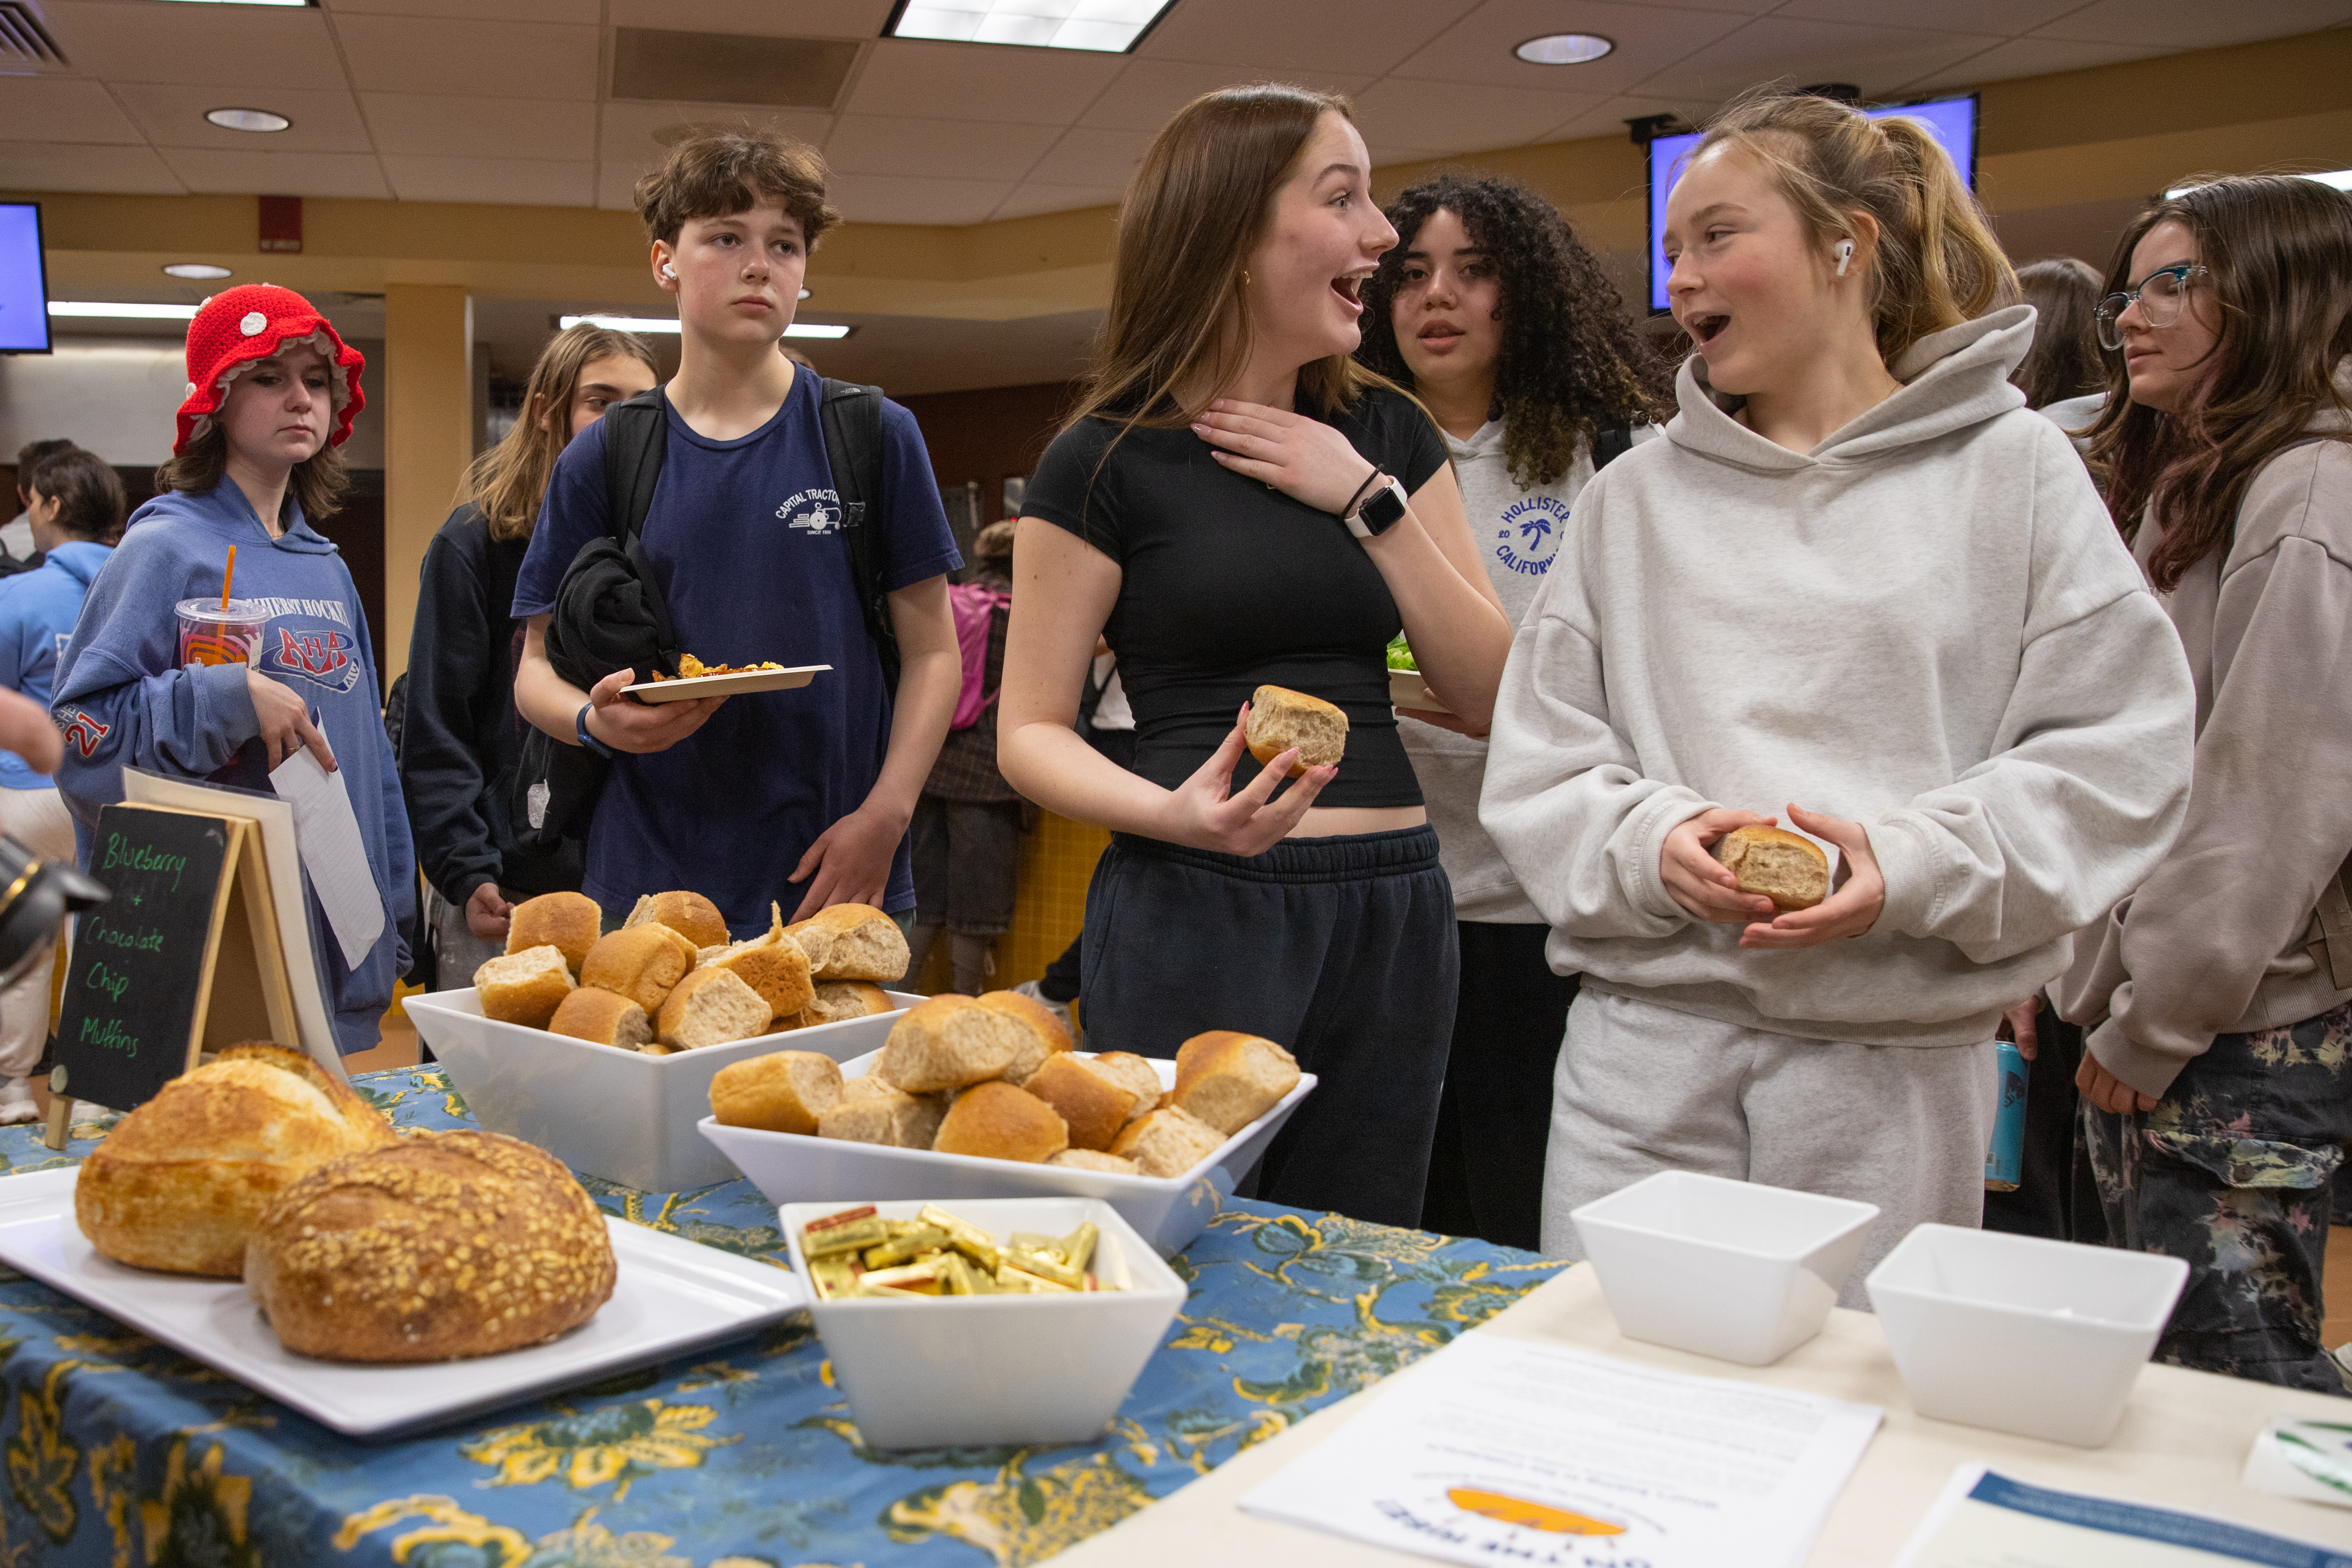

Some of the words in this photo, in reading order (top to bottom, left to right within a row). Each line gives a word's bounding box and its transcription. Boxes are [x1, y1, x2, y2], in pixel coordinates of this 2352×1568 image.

[775, 492, 807, 519] CAPITAL
[1501, 496, 1571, 523] HOLLISTER
[1499, 530, 1510, 538] 20
[1496, 545, 1560, 576] CALIFORN
[63, 711, 110, 758] 21
[104, 832, 187, 892] Blueberry
[85, 916, 164, 952] Chocolate
[87, 962, 129, 1002] Chip
[81, 1016, 139, 1058] Muffins
